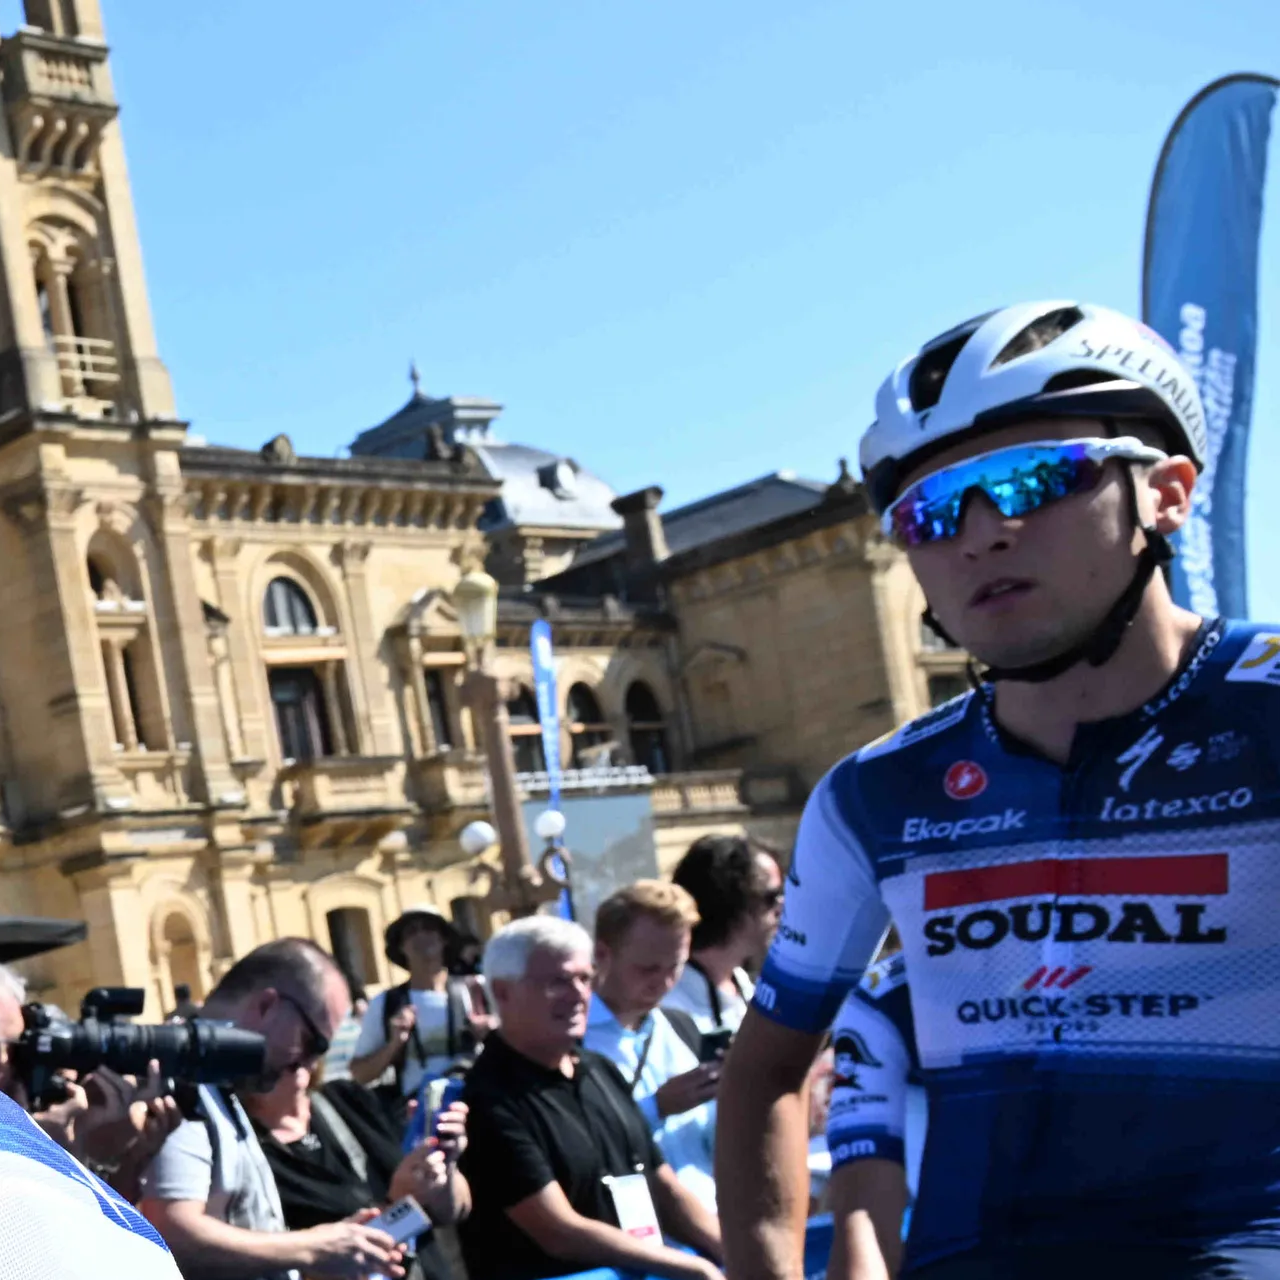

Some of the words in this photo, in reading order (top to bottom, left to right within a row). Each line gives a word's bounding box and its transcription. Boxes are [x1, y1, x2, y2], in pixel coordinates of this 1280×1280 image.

[1100, 787, 1253, 821] latexco
[902, 809, 1027, 843] Ekopak
[924, 902, 1227, 957] SOUDAL
